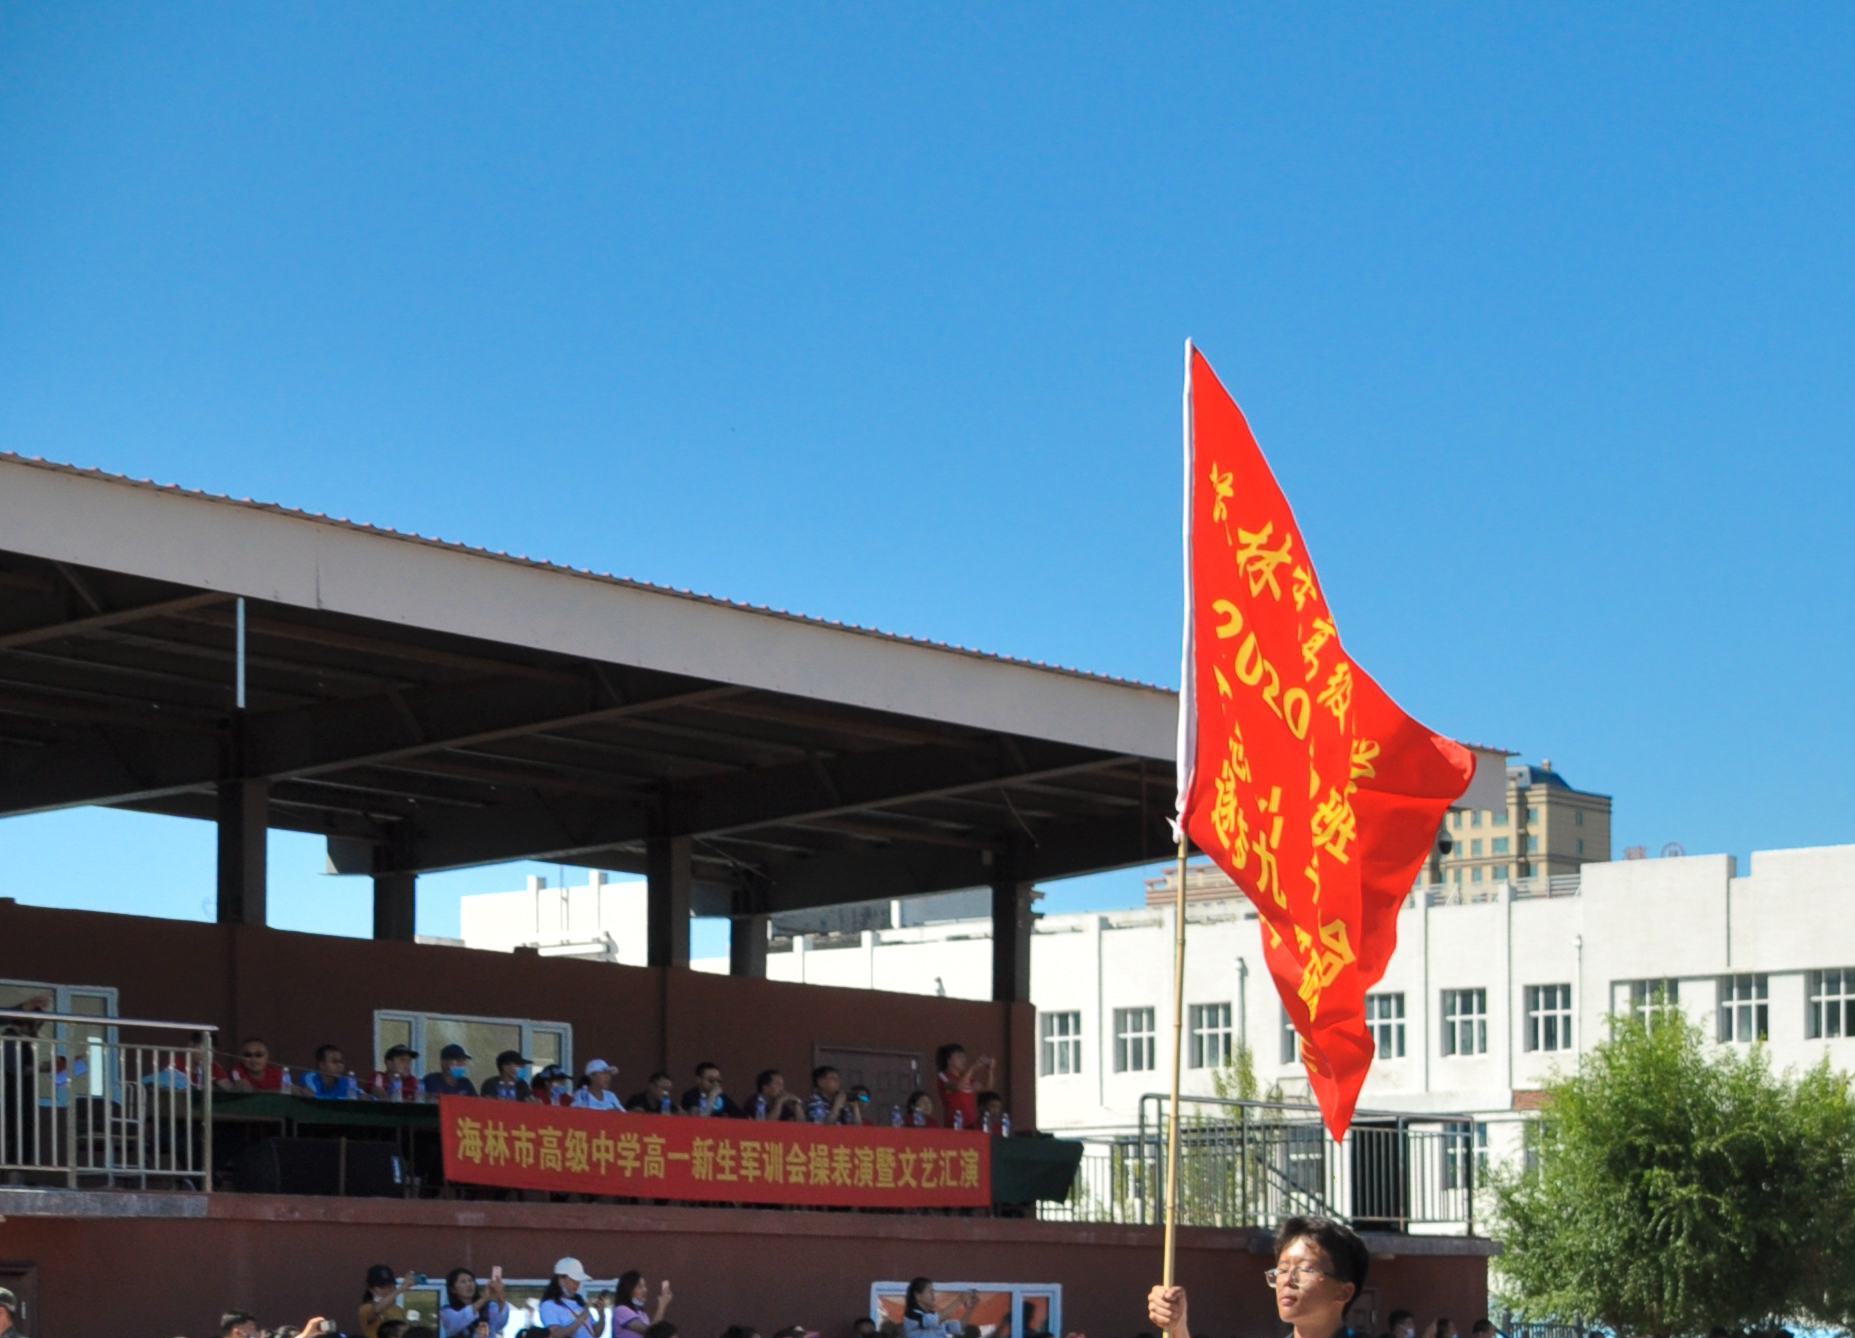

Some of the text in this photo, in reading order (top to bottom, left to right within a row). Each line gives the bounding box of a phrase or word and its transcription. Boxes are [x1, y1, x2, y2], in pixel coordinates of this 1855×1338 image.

[457, 1117, 979, 1188] 海林市高级中学高一新生军训会操表演暨文艺汇演
